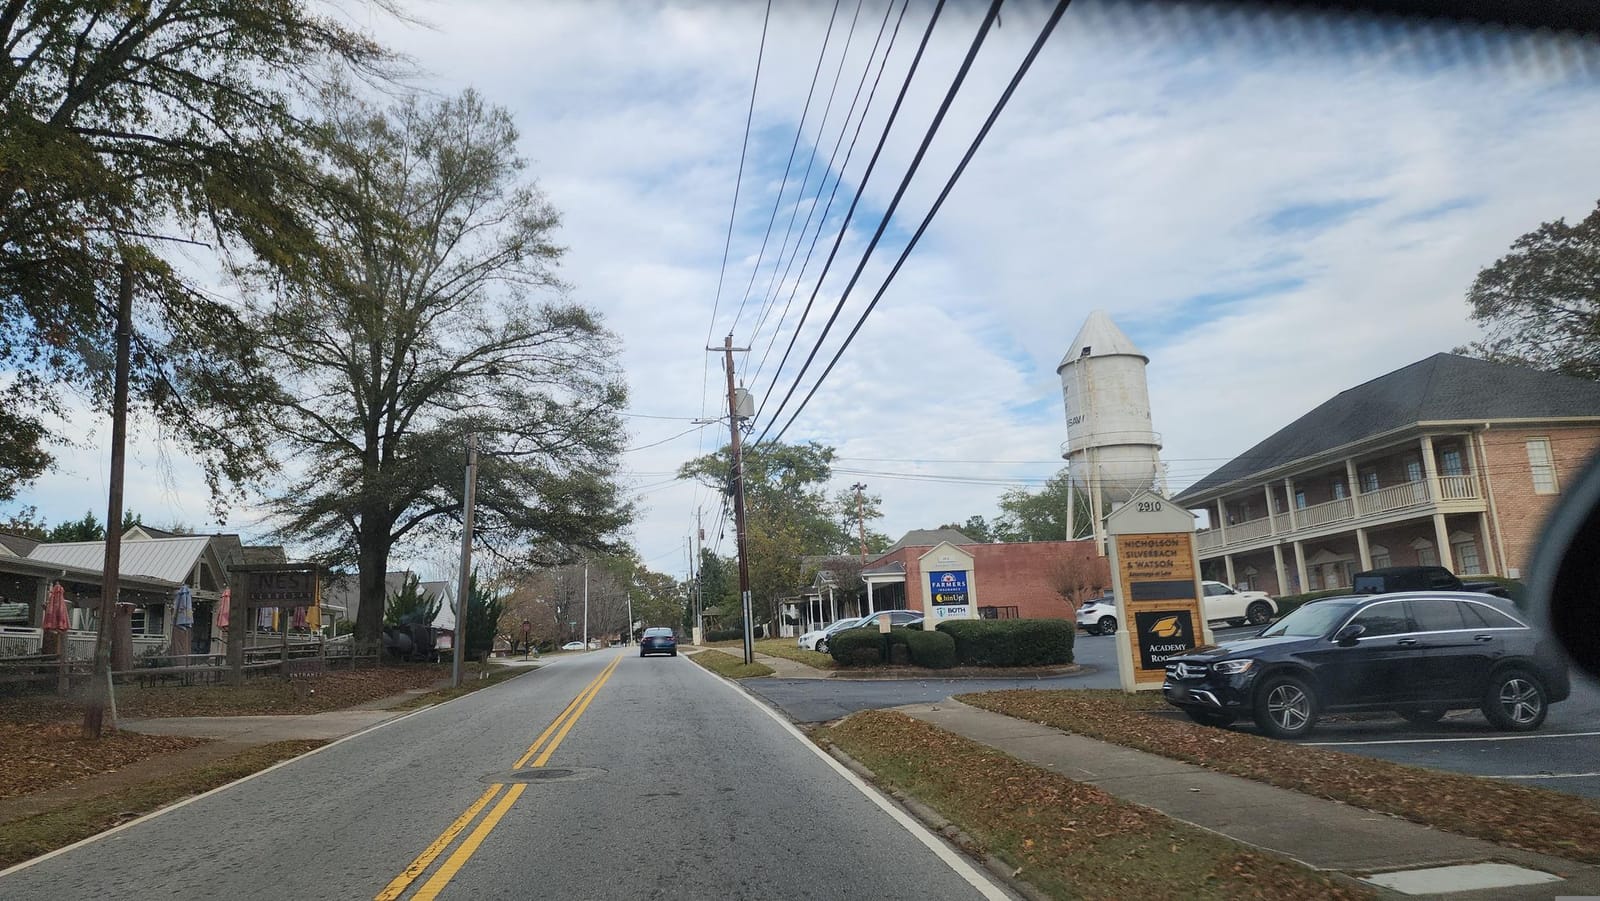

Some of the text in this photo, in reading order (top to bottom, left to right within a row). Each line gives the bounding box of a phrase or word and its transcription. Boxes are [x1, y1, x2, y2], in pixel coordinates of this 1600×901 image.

[1138, 502, 1162, 512] 2910
[1124, 540, 1179, 548] NICHOLSON
[1136, 560, 1174, 569] WATSON
[1149, 643, 1186, 652] ACADEMY
